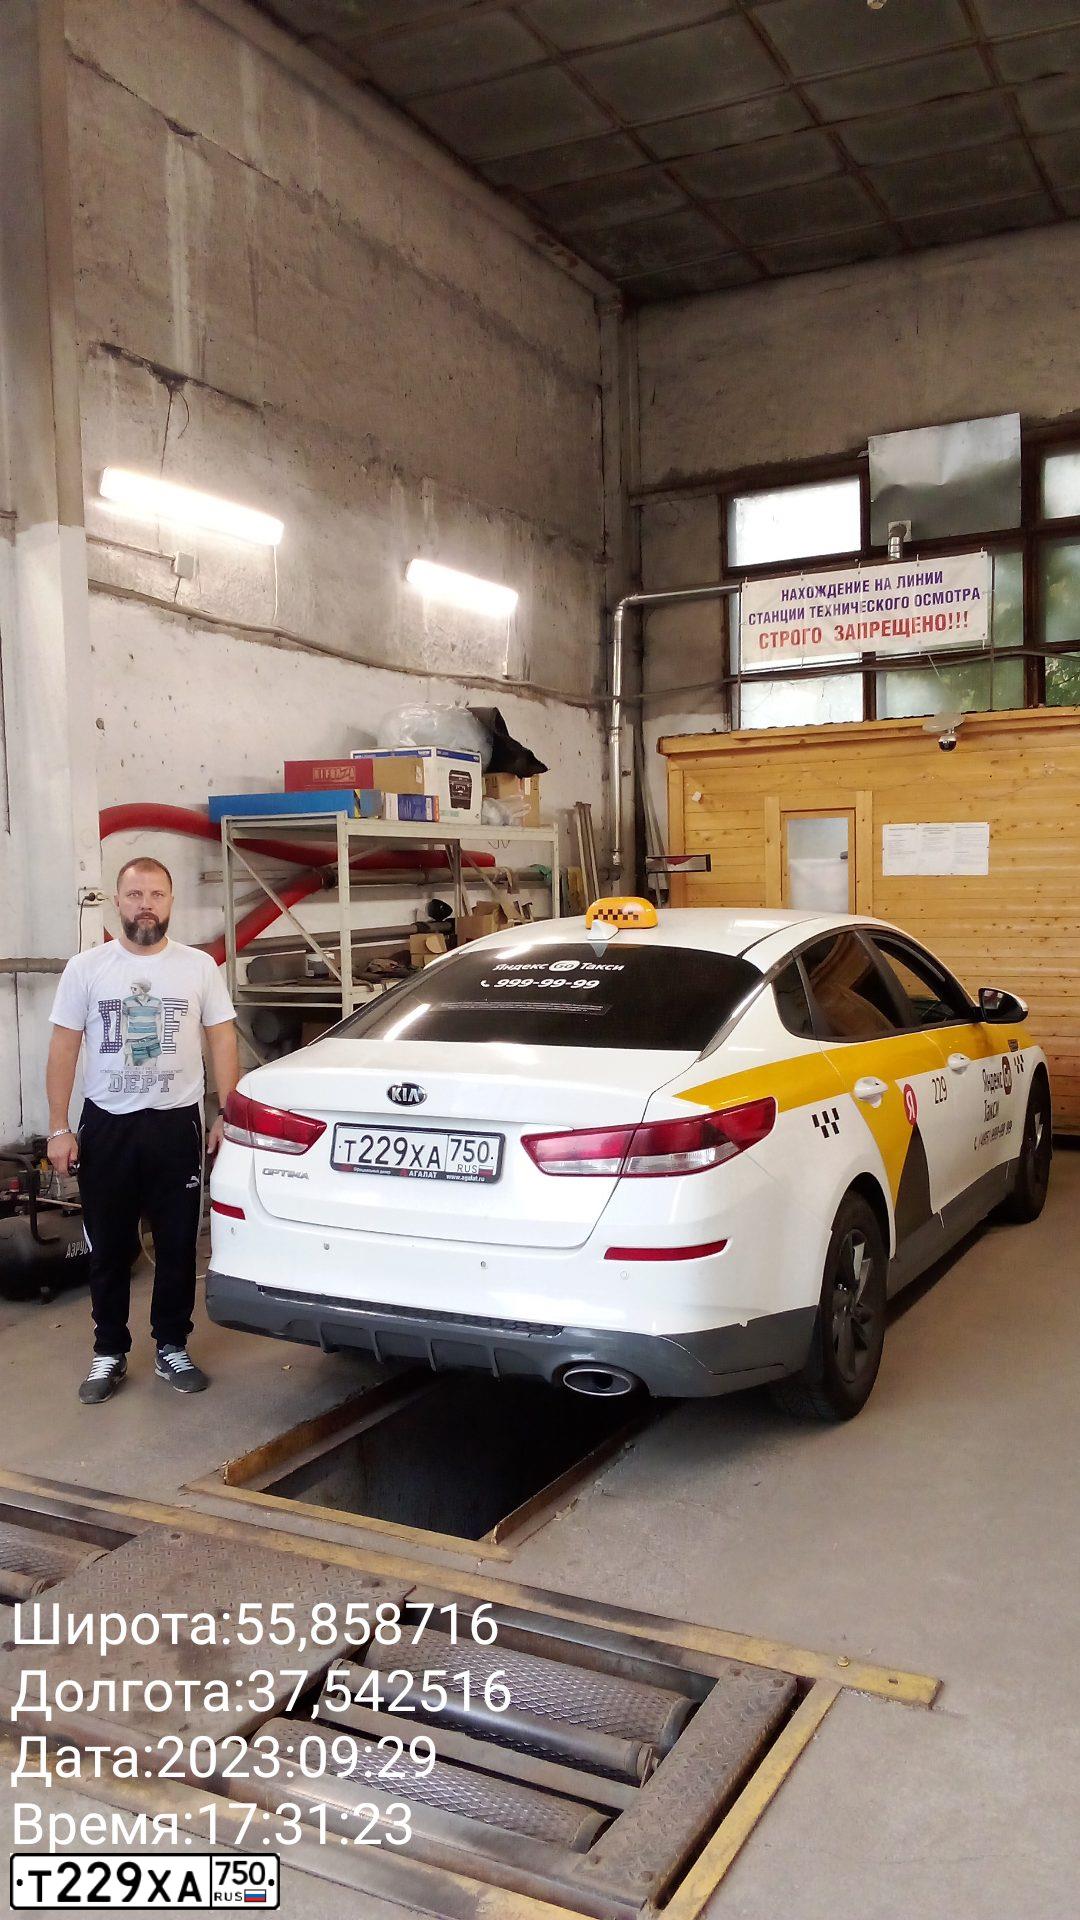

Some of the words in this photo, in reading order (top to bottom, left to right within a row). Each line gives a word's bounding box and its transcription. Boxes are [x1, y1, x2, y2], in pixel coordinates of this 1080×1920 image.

[781, 579, 870, 602] НАХОЖДЕНИЕ
[874, 579, 892, 593] НА
[896, 571, 944, 589] ЛИНИИ
[748, 605, 805, 625] СТАНЦИИ
[809, 595, 909, 619] ТЕХНИЧЕСКОГО
[914, 587, 980, 608] ОСМОТРА
[759, 626, 822, 650] СТРОГО
[834, 610, 969, 642] ЗАПРЕЩЕНО!!!
[492, 963, 550, 971] Яндекс
[580, 962, 625, 971] Такси
[494, 978, 600, 989] 999-99-99
[108, 1073, 175, 1094] DEPT
[391, 1086, 420, 1102] KIA
[931, 1075, 948, 1104] 229
[450, 1138, 490, 1164] 750
[409, 1170, 437, 1179] АГАЛАТ
[457, 1163, 478, 1174] RUS
